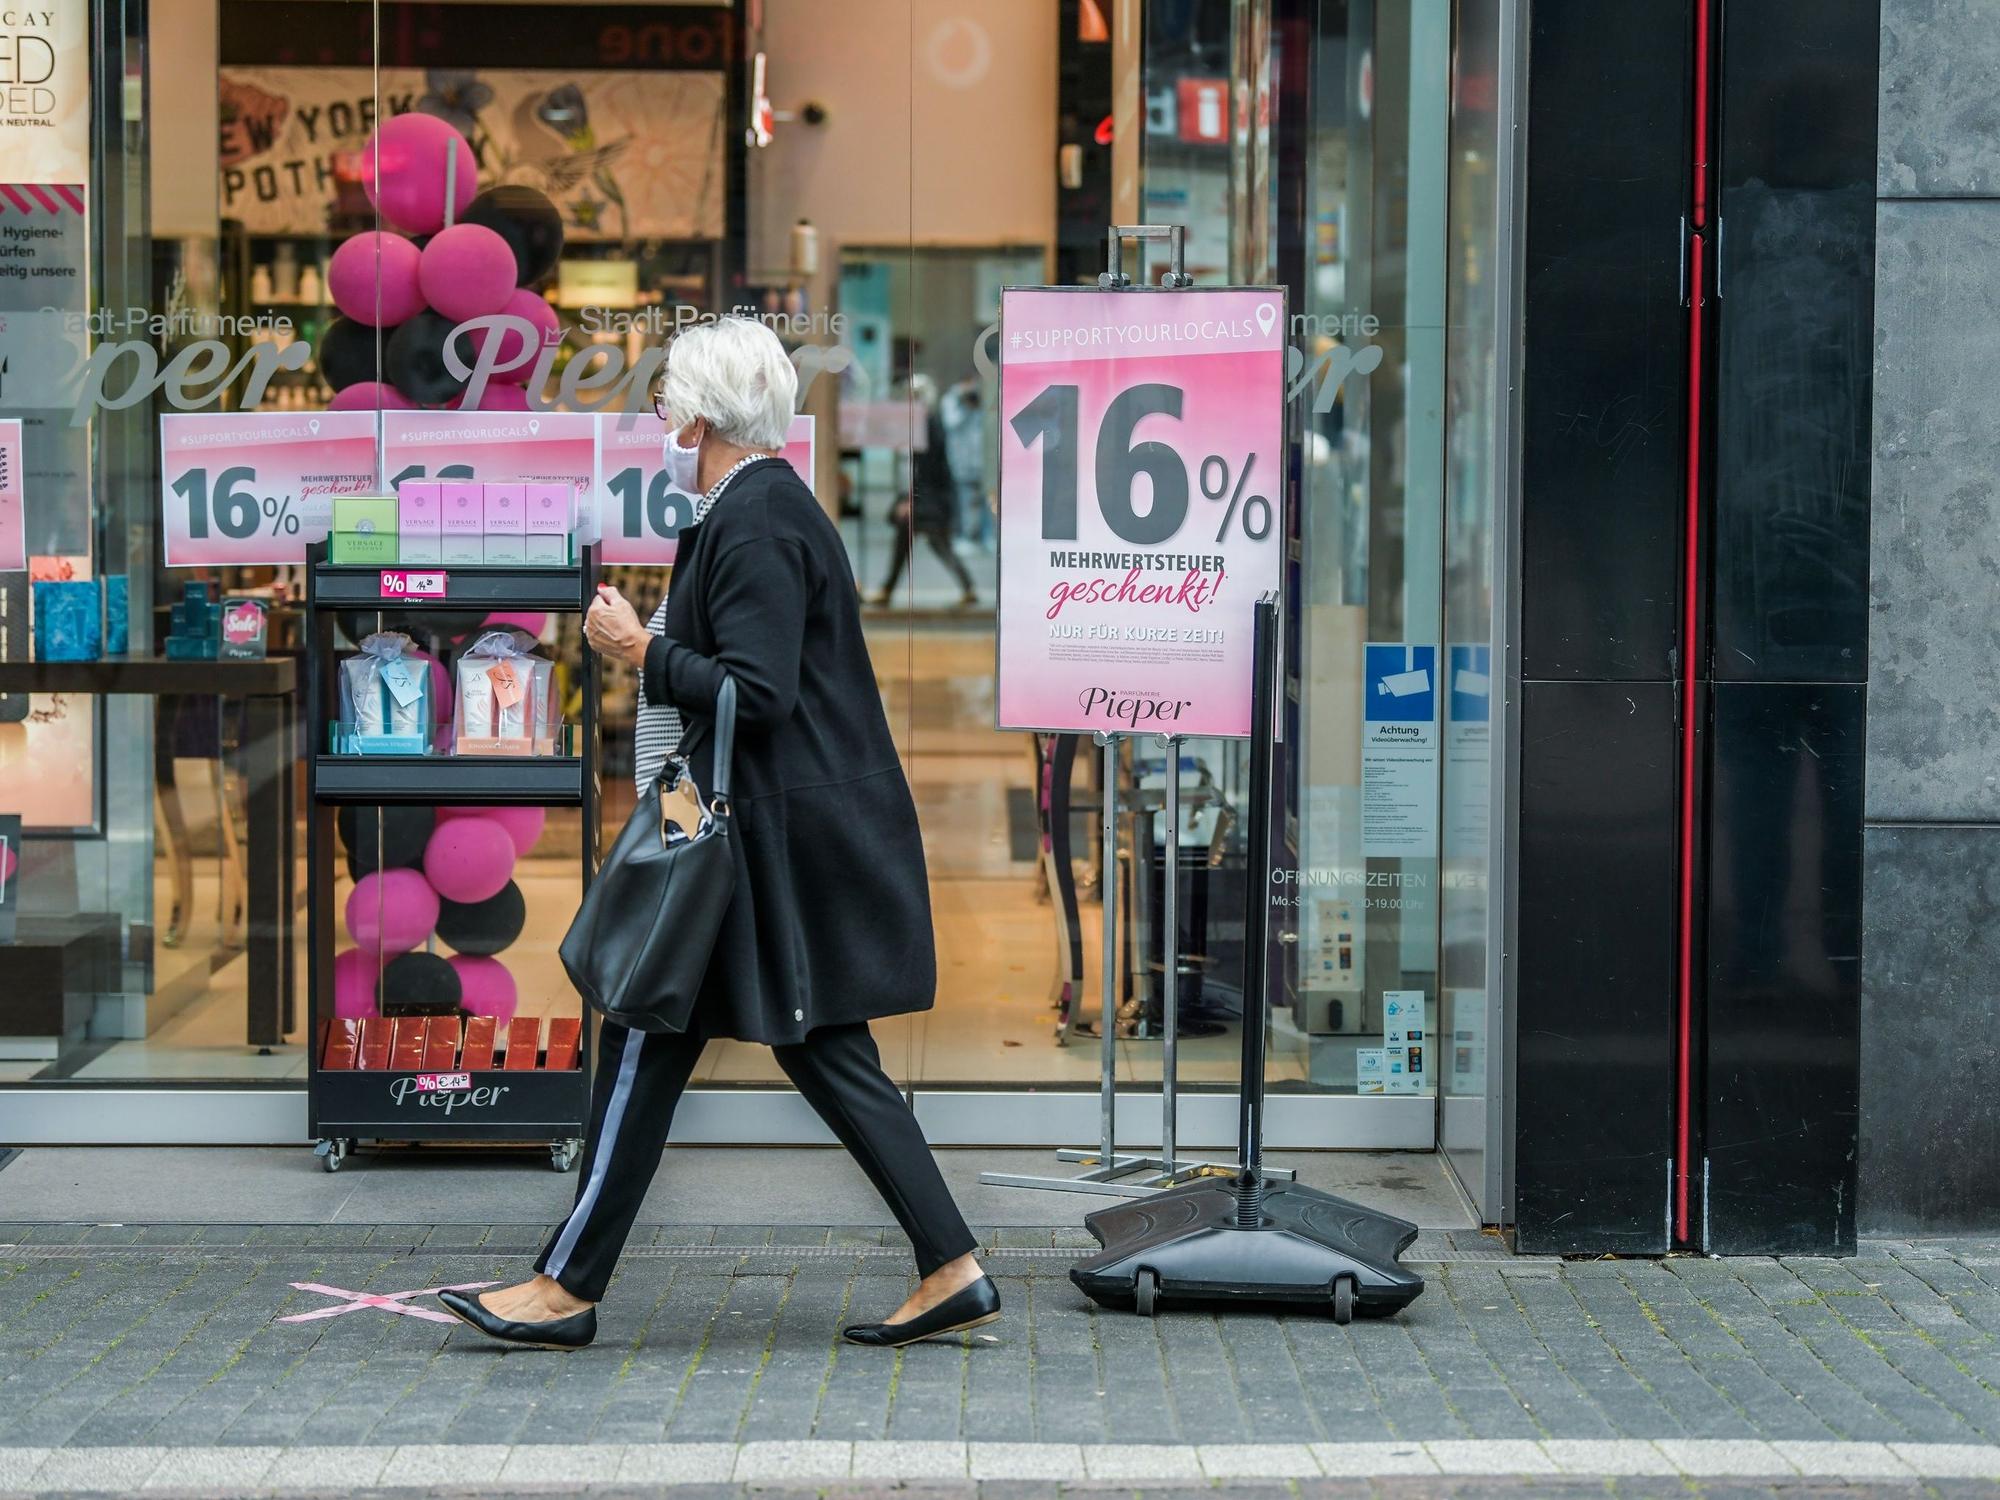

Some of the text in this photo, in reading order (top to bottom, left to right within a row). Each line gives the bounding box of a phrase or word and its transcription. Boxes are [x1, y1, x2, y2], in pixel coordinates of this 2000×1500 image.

[0, 87, 56, 115] ED
[3, 226, 64, 241] Hygiene-
[31, 267, 77, 277] unsere
[1010, 318, 1253, 350] #SUPPORTYOURLOCALS
[62, 339, 312, 428] per
[180, 427, 309, 446] #SUPPORTYOURLOCALS
[401, 426, 529, 443] #SUPPORTYOURLOCALS
[606, 467, 703, 540] 16
[1050, 551, 1226, 573] MEHRWERTSTEUER
[227, 613, 258, 633] Sale
[1049, 622, 1225, 645] NUR FÜR KURZE ZEIT!
[1078, 687, 1192, 729] Pieper
[1371, 736, 1428, 744] Videoüberwachung!
[1379, 725, 1419, 737] Achtung
[1271, 867, 1427, 888] ÖFFNUNGSZEITEN
[1271, 895, 1301, 907] Mo.-S
